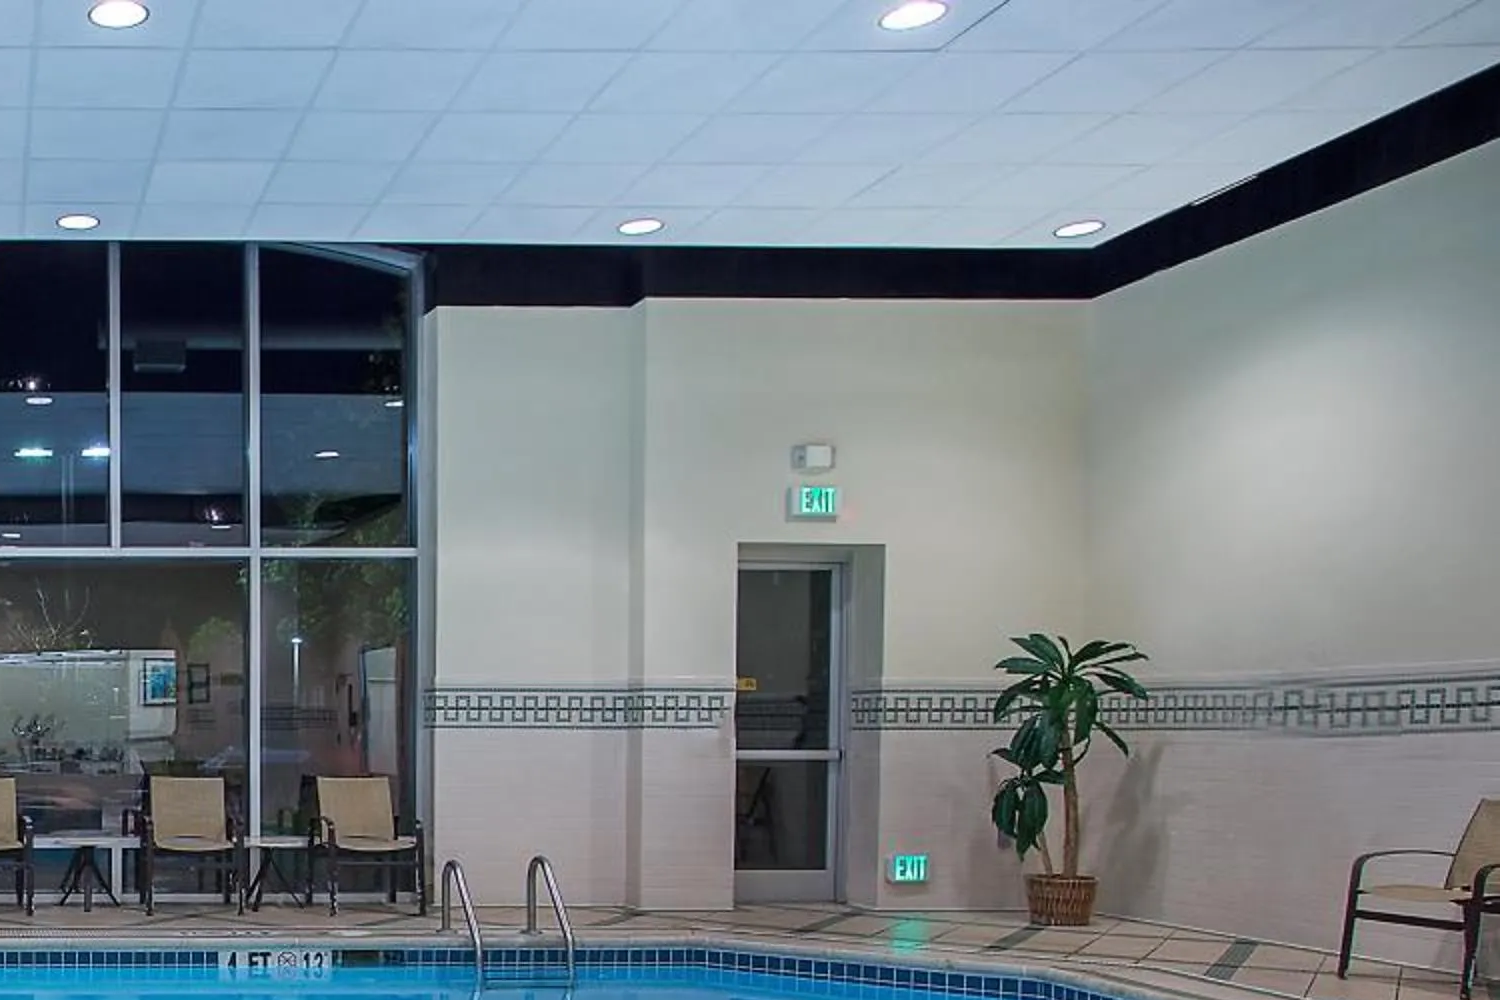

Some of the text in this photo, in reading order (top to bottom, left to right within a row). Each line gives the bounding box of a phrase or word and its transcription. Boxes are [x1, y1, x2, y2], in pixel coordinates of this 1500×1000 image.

[802, 487, 836, 513] EXIT
[895, 855, 927, 881] EXIT
[248, 952, 271, 968] FT
